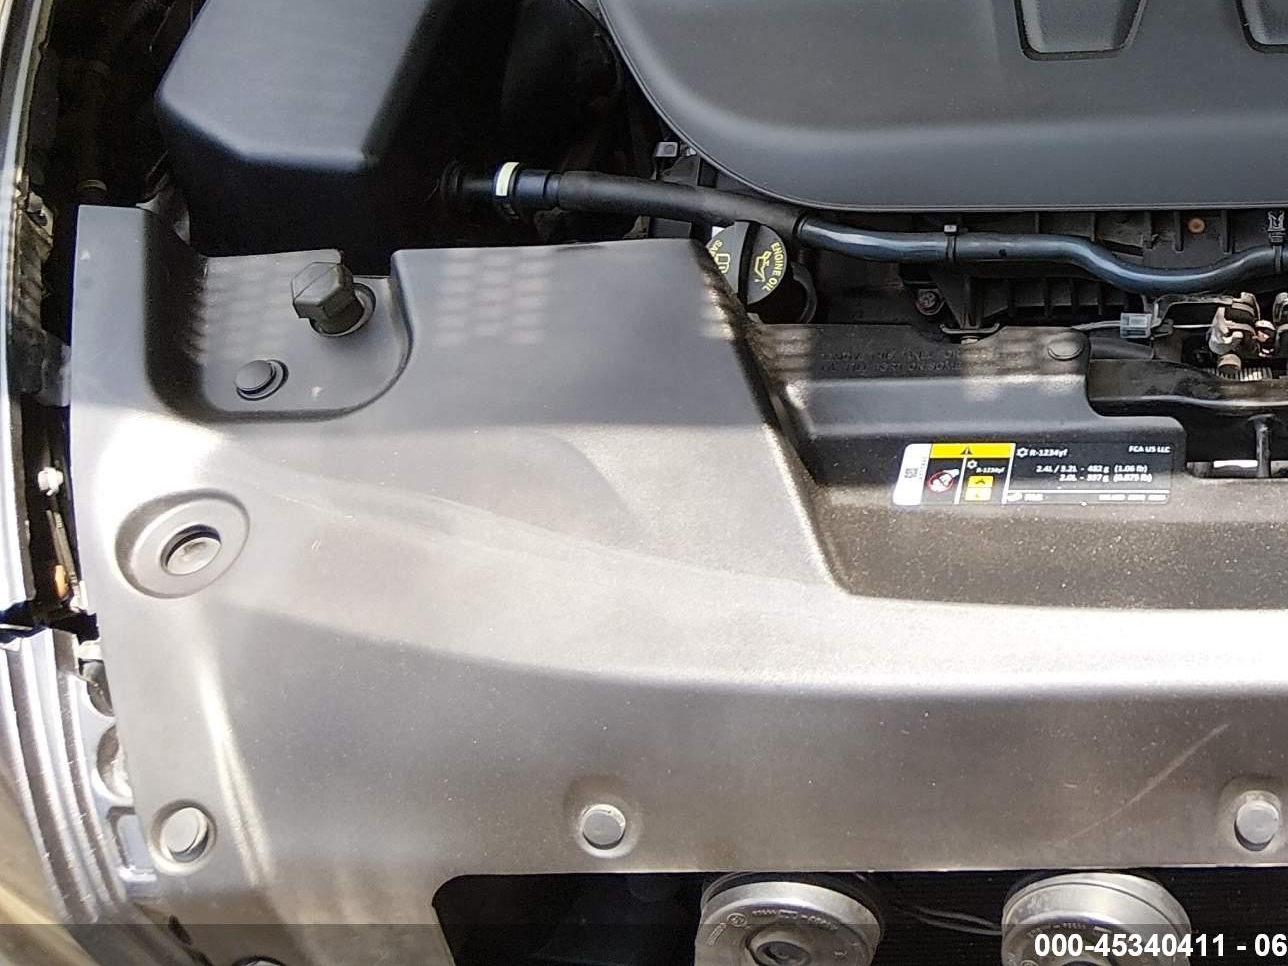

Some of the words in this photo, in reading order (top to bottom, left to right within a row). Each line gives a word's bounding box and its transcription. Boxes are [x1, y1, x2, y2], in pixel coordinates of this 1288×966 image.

[770, 242, 784, 276] ENGINE
[762, 277, 778, 291] OIL
[1029, 448, 1069, 458] R-1234yf
[1128, 445, 1144, 453] FCA
